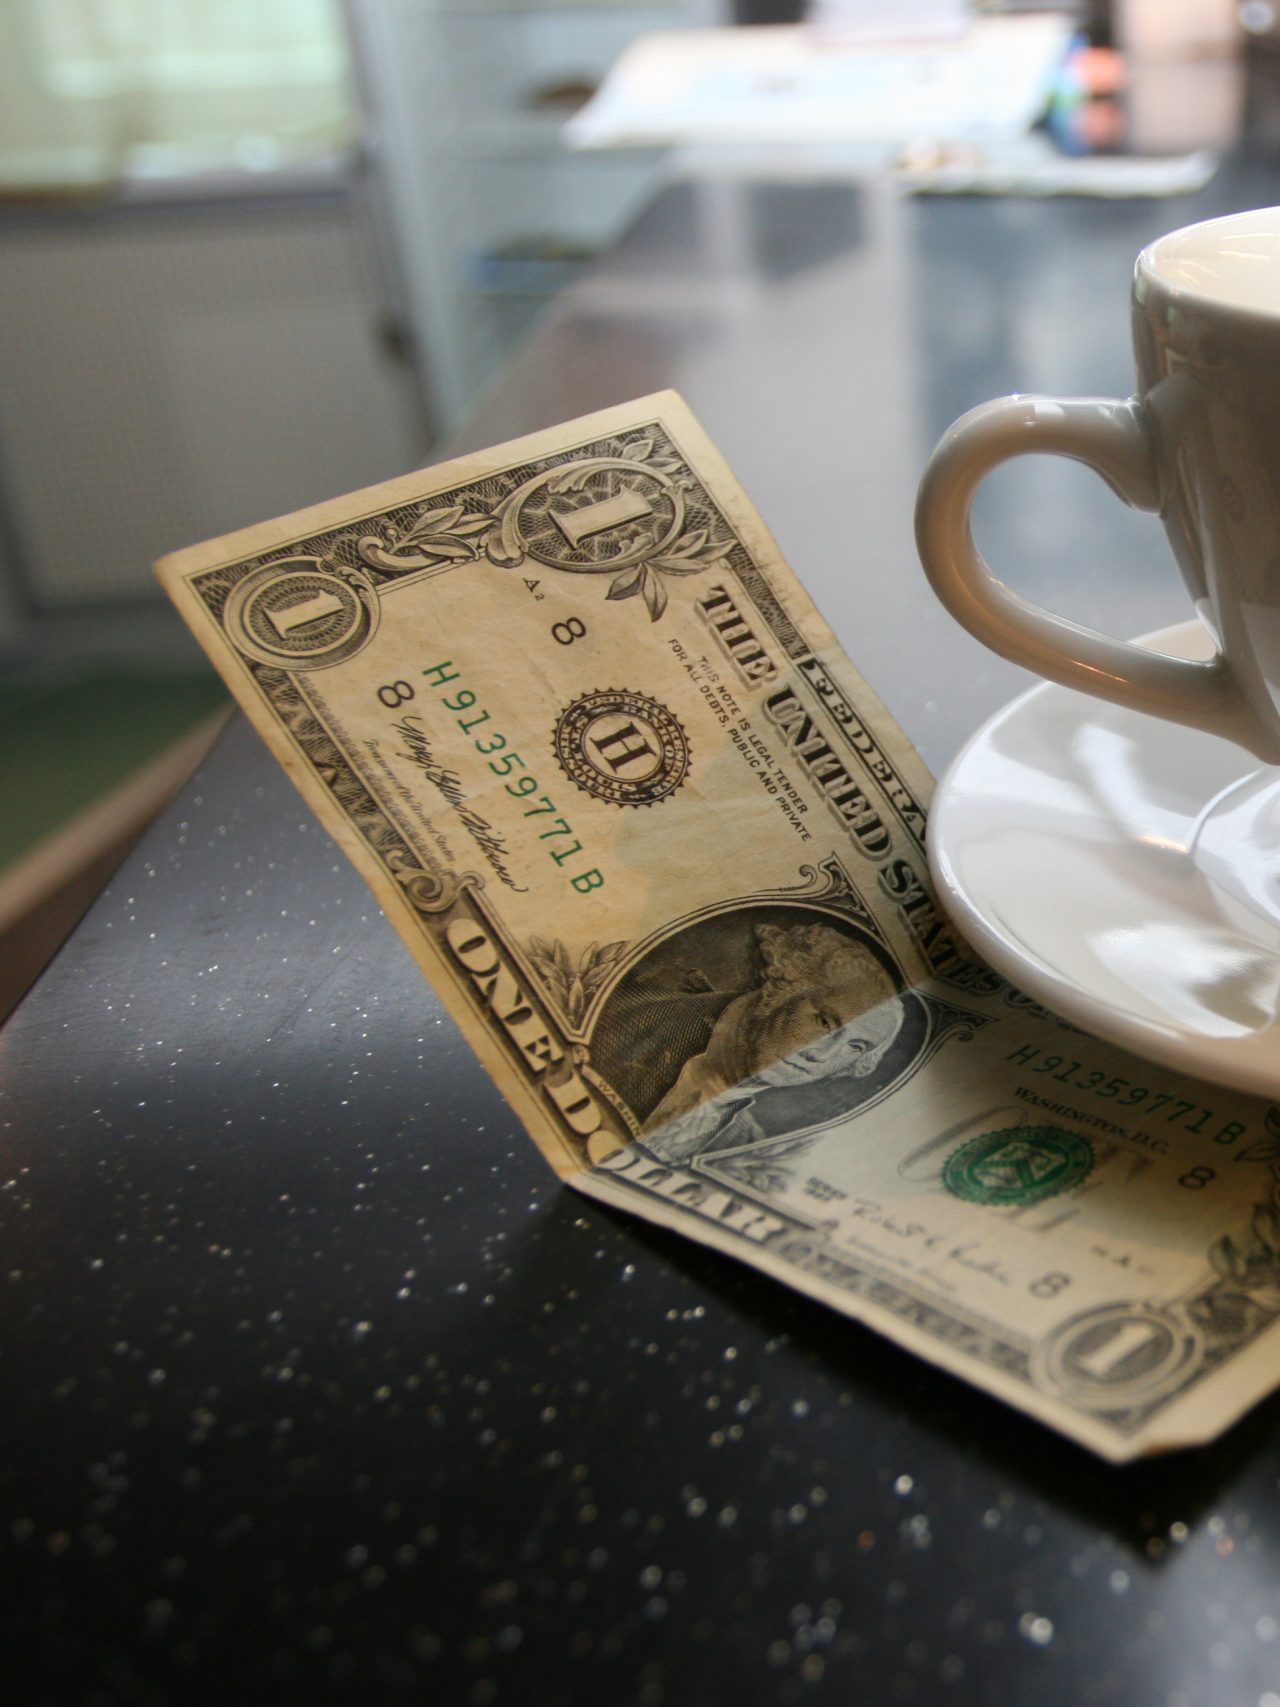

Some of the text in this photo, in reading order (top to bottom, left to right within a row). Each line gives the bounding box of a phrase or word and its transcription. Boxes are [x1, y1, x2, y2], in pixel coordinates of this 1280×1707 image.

[548, 485, 656, 551] 1
[263, 589, 346, 640] 1
[551, 615, 587, 647] 8
[377, 679, 416, 709] 8
[695, 585, 777, 692] THE
[761, 683, 893, 862] UNITED
[589, 720, 657, 775] H
[666, 636, 812, 843] FOR ALL DEBTS, PUBLIC AND PRIVATE
[695, 654, 809, 815] THIS NOTE IS LEGAL TENDER
[811, 674, 927, 839] FEDERA
[445, 917, 565, 1073] ONE
[543, 1062, 788, 1245] DOLLAR
[1178, 1165, 1216, 1190] 8
[1028, 1270, 1072, 1298] 8
[1075, 1320, 1155, 1379] 1
